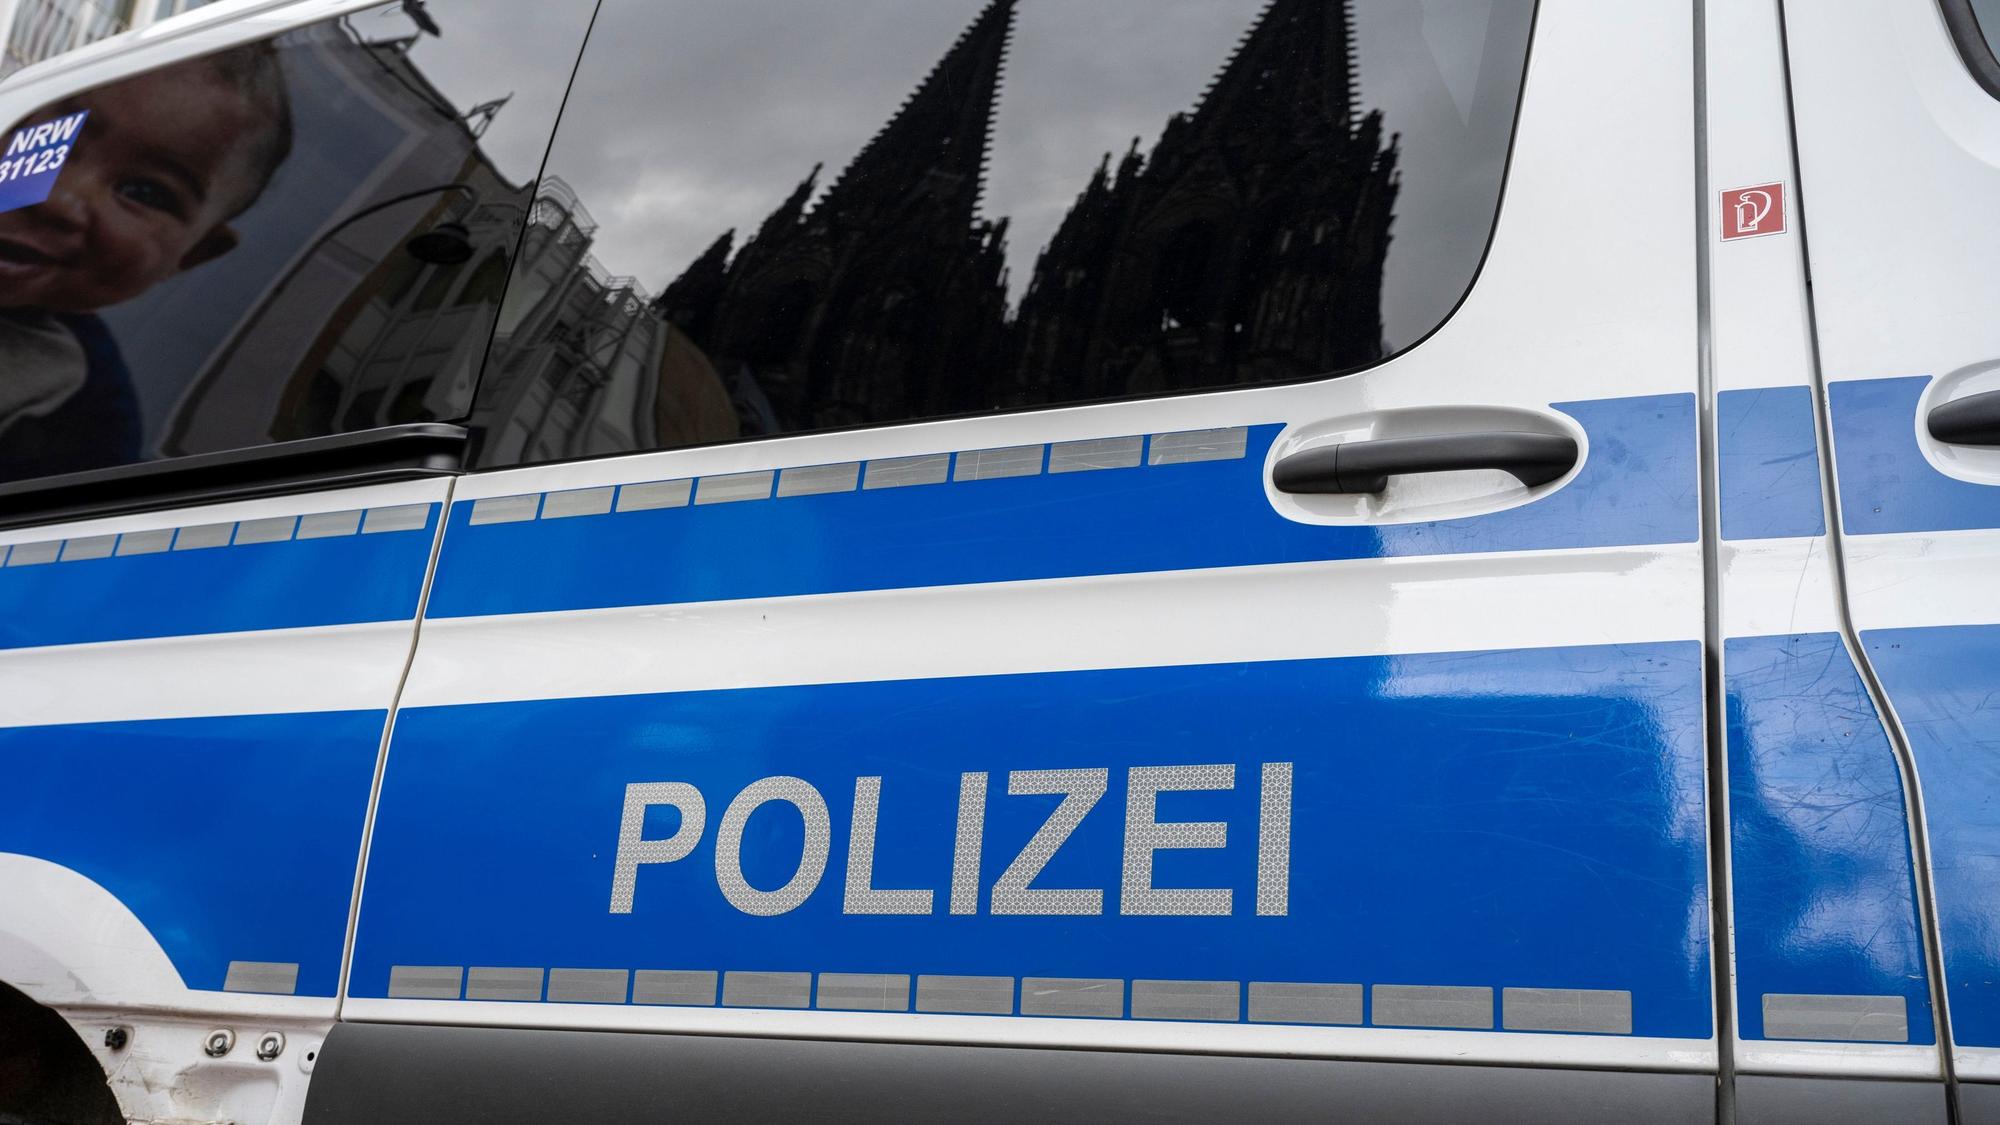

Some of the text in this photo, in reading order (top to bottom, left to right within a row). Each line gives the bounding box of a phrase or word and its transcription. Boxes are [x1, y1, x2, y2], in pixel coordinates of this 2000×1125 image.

[7, 113, 84, 156] NRW
[0, 145, 69, 183] 31123
[608, 761, 1293, 917] POLIZEI
